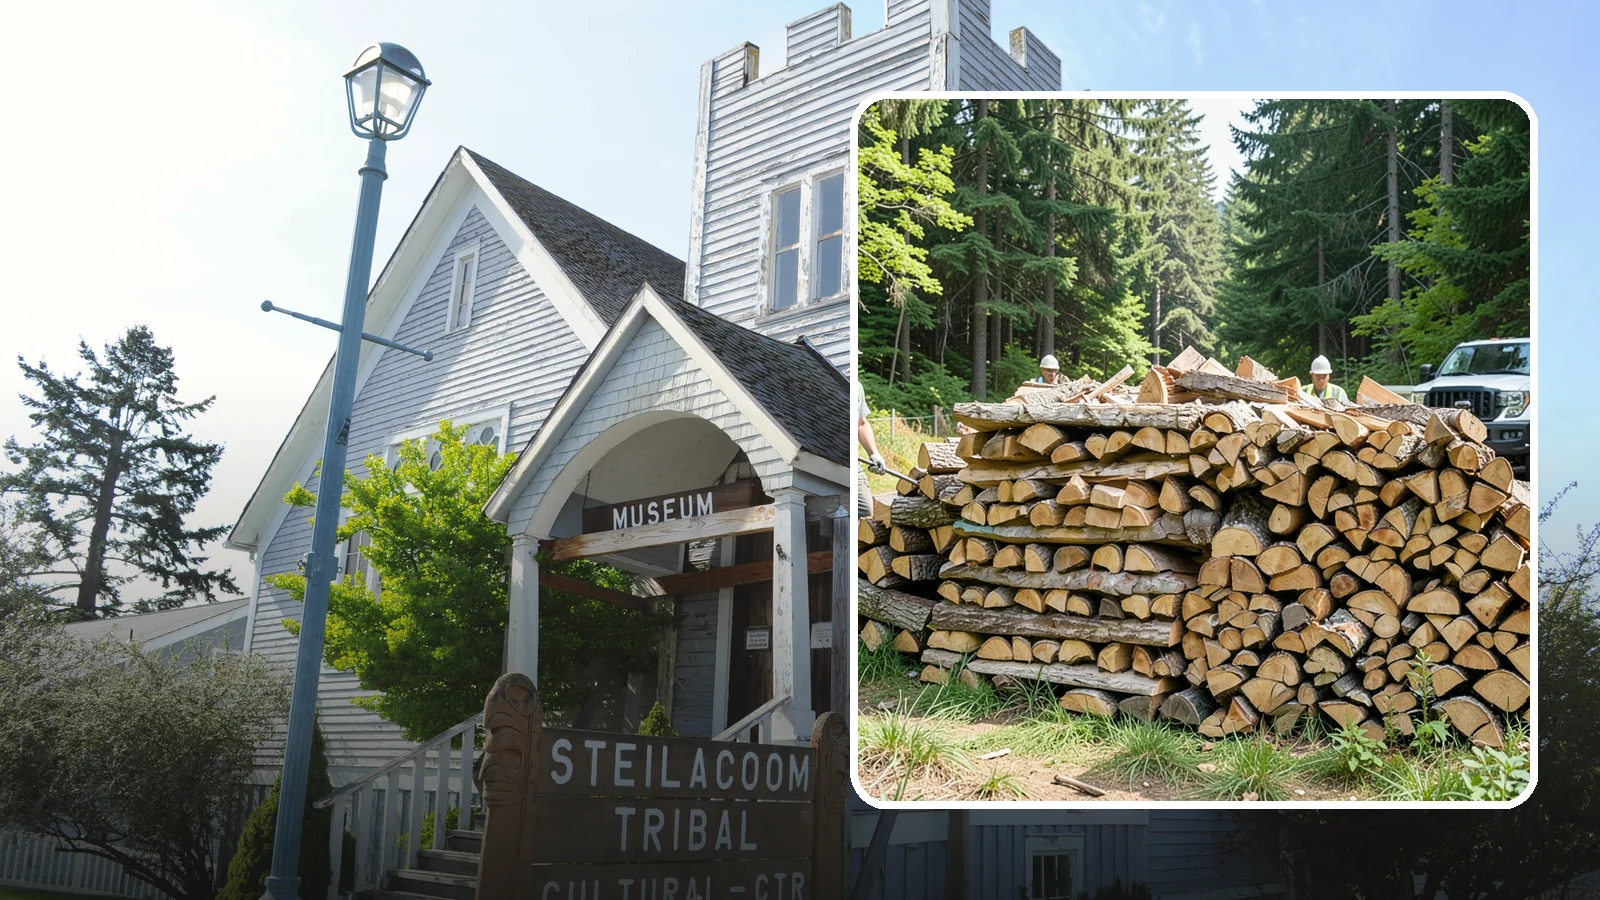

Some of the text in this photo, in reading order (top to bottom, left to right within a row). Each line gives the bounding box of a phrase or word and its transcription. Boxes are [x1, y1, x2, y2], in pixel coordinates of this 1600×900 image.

[613, 492, 713, 530] MUSEUM
[551, 738, 809, 792] STEILACOOM
[615, 807, 757, 851] TRIBAL
